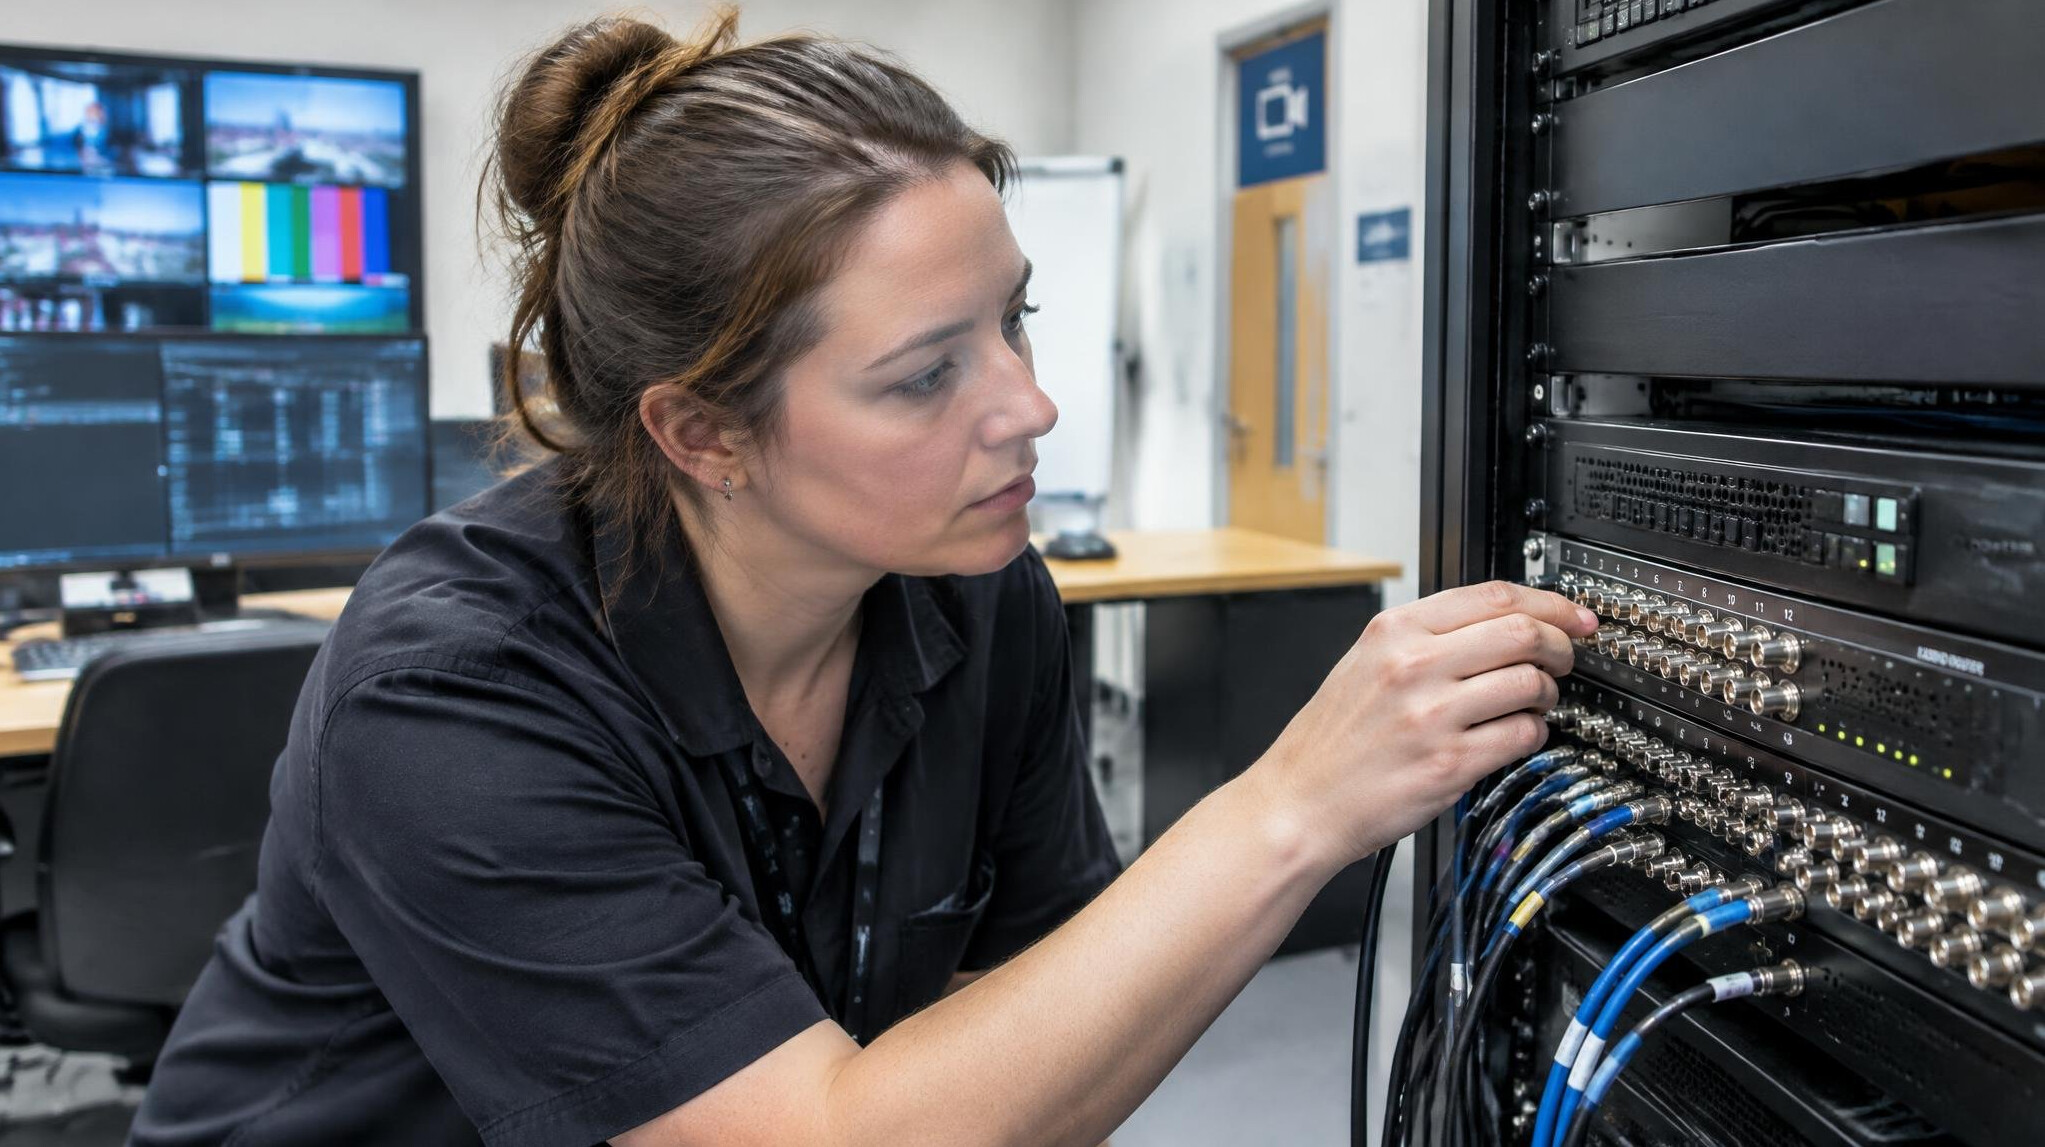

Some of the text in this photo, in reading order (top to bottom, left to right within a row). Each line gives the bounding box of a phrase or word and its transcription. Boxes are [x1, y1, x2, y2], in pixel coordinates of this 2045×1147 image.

[1654, 574, 1659, 584] 6
[1702, 587, 1707, 598] 8
[1727, 594, 1736, 606] 10
[1755, 601, 1764, 613] 11
[1784, 608, 1793, 622] 12
